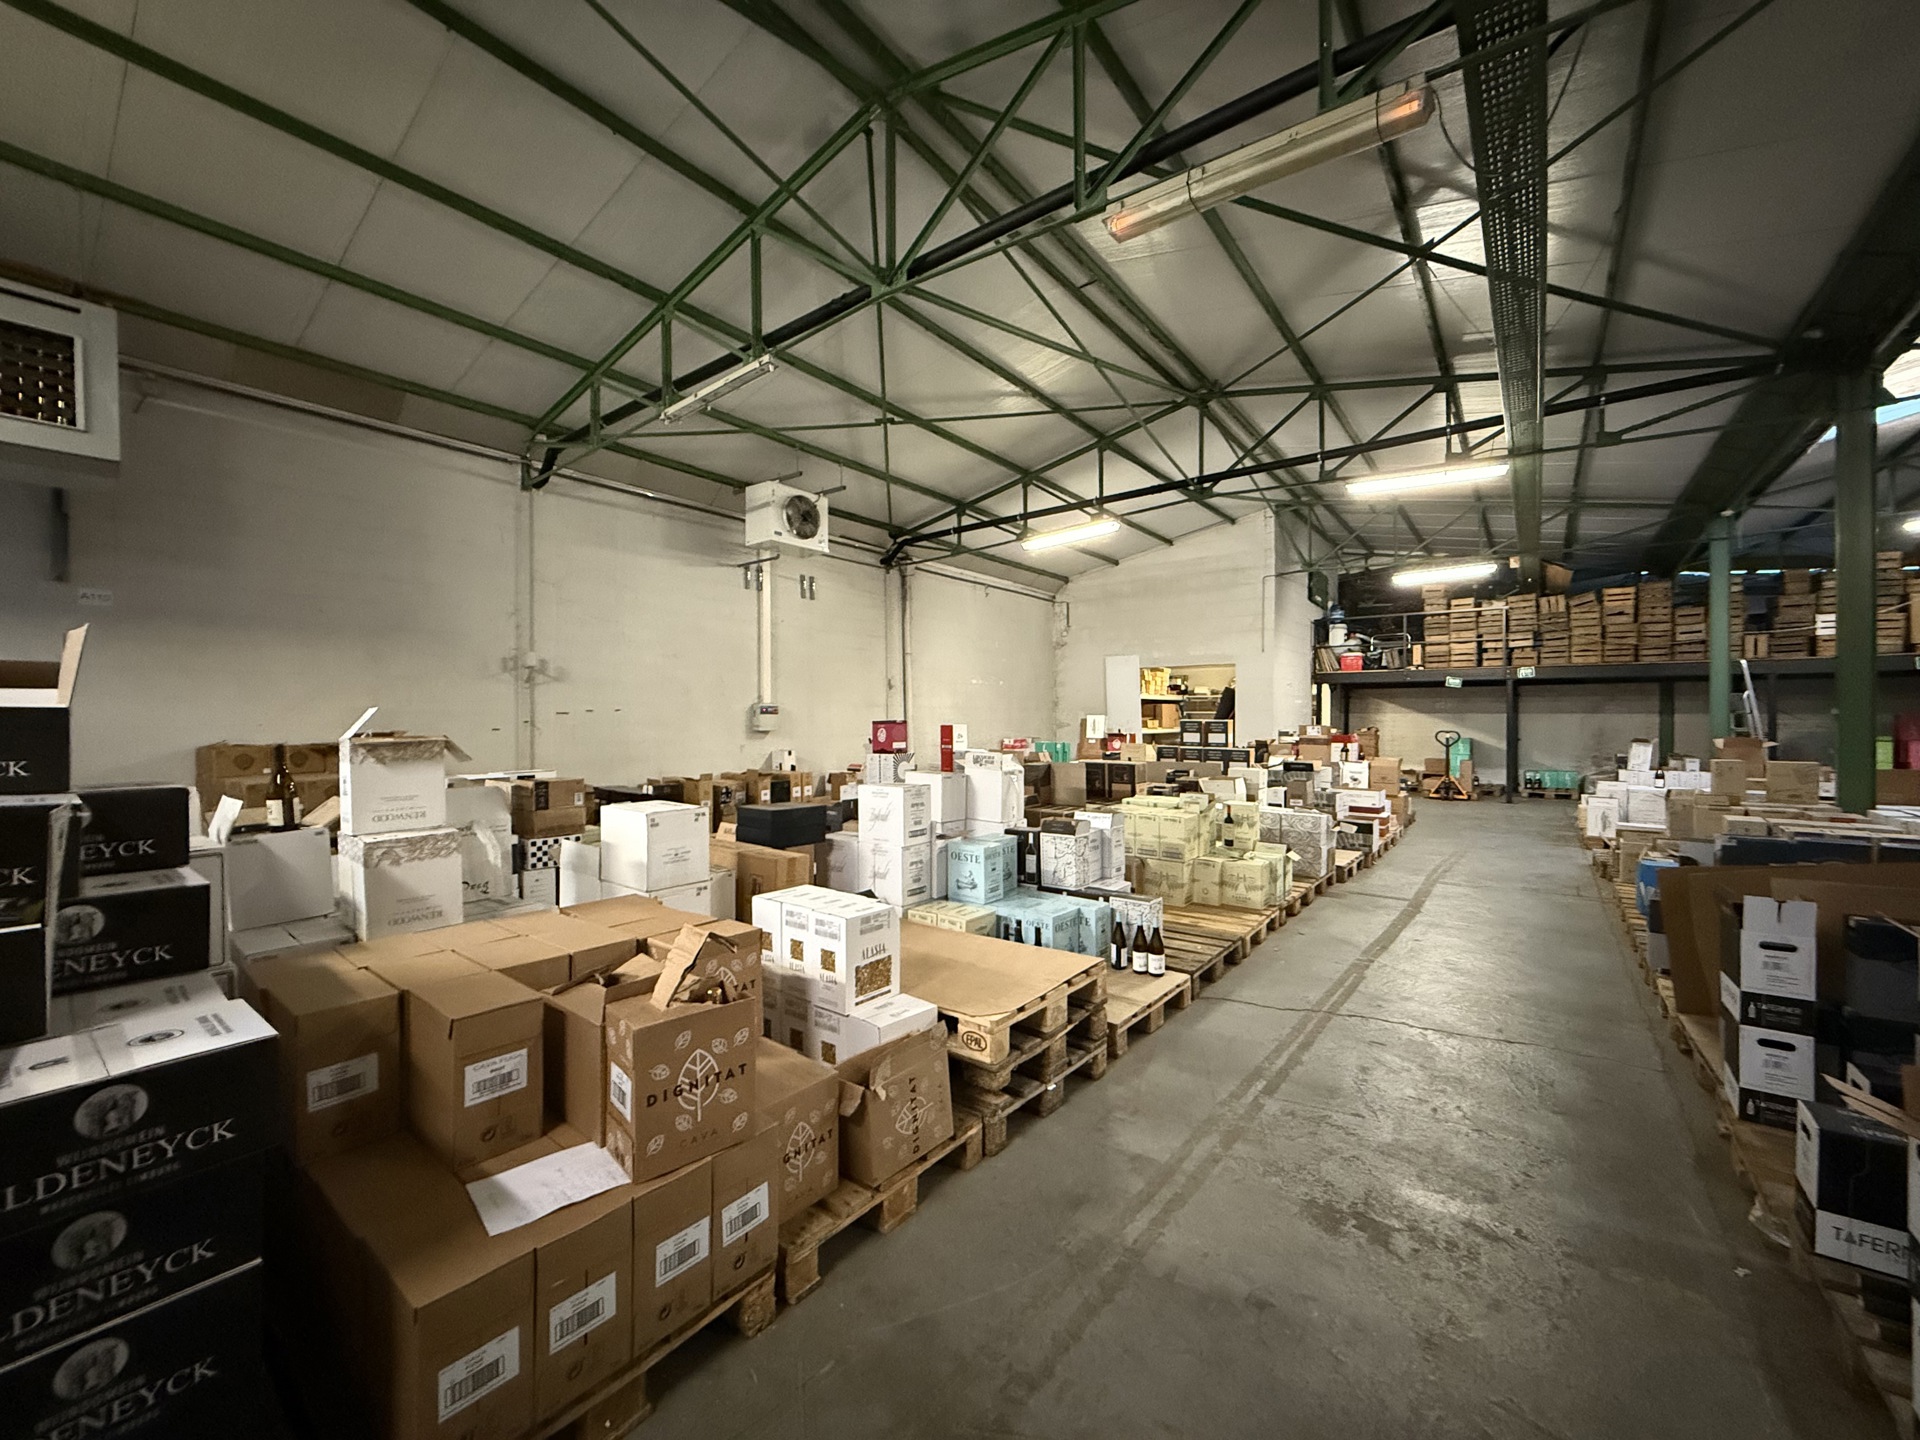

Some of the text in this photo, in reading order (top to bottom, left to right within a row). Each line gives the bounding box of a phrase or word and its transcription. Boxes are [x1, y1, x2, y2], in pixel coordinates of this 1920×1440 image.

[79, 838, 157, 862] EYCK
[951, 849, 982, 864] OESTE
[733, 979, 757, 992] TAT
[646, 1063, 747, 1108] DIGNITAT
[908, 1077, 920, 1155] DIGNITAT
[680, 1128, 718, 1148] CAVA
[783, 1128, 833, 1164] GNITAT
